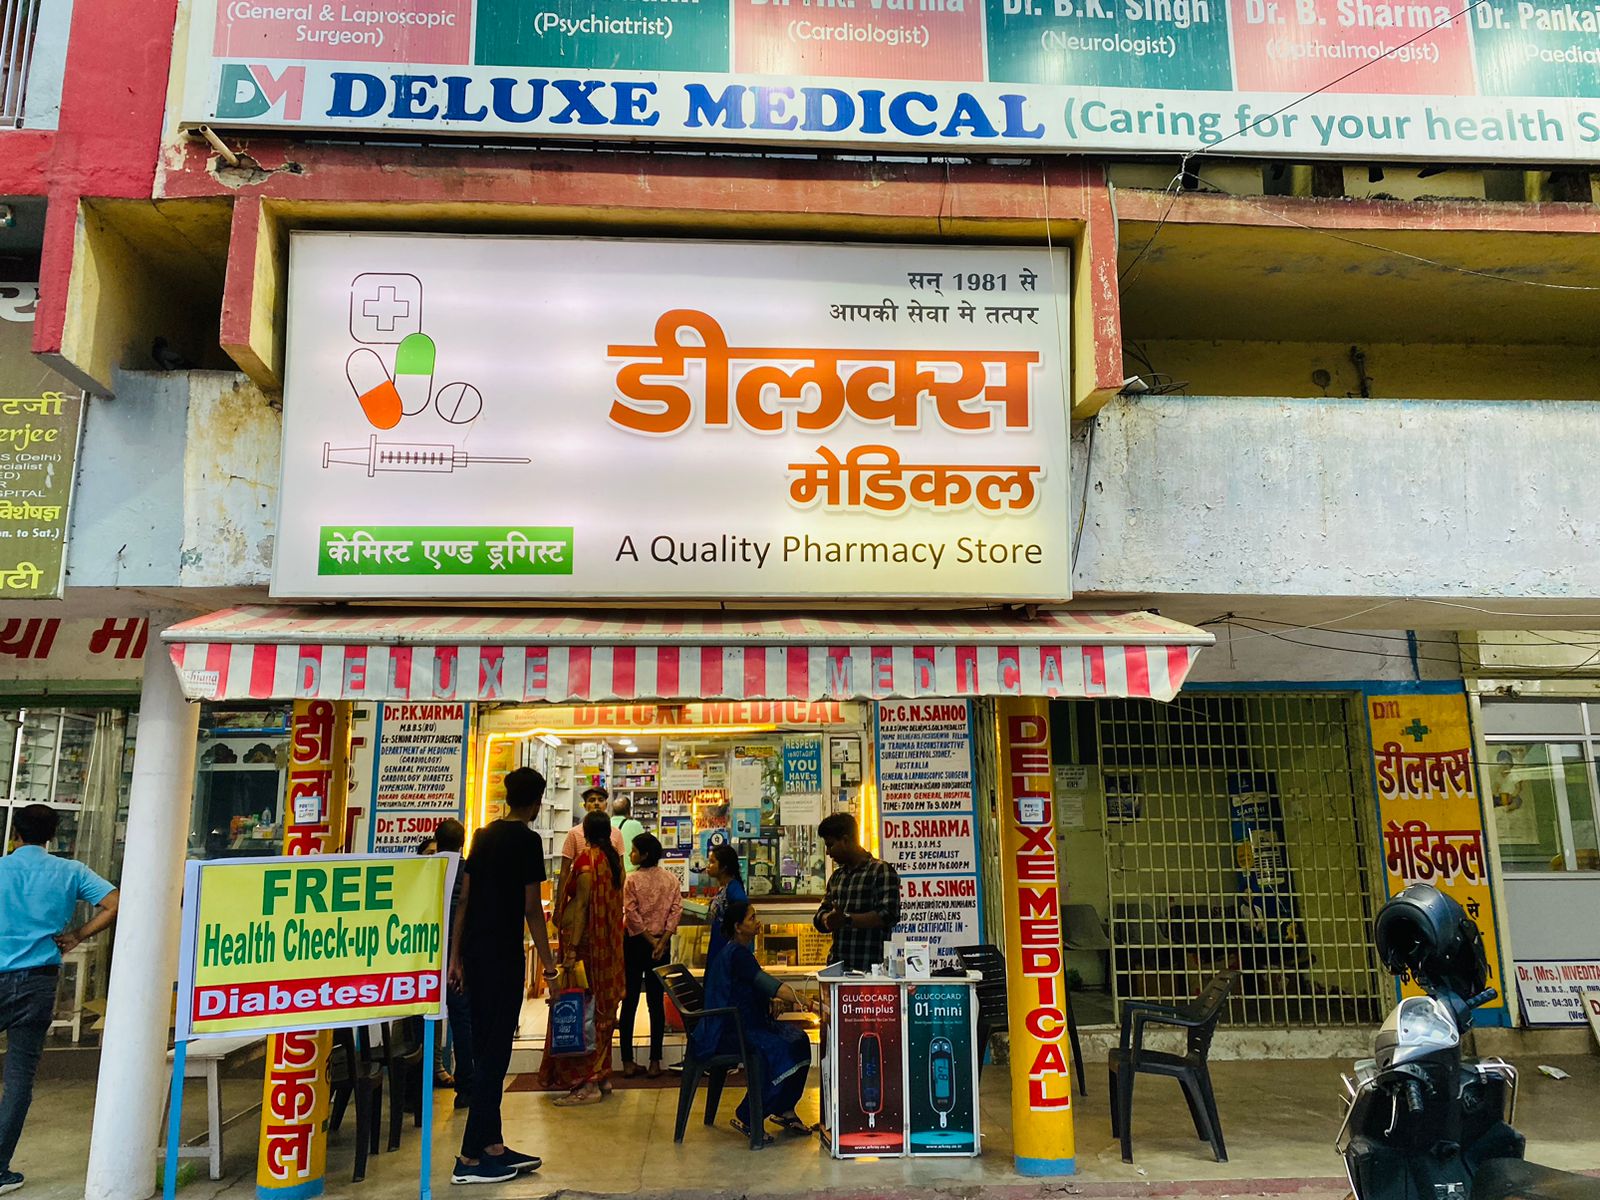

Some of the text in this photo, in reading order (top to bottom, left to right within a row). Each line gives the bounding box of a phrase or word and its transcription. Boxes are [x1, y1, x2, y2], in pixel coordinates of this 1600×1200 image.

[227, 2, 456, 28] (General & Laproscopic
[534, 12, 673, 39] (Psychiatrist)
[1246, 0, 1453, 30] Dr. B. Sharma
[1476, 2, 1511, 30] Dr.
[297, 26, 384, 48] Surgeon)
[787, 20, 930, 47] (Cardiologist)
[1041, 30, 1177, 57] (Neurologist)
[325, 71, 660, 127] DELUXE
[683, 83, 1046, 139] MEDICAL
[1064, 97, 1223, 144] (Caring
[1234, 104, 1298, 138] for
[1311, 110, 1411, 146] your
[1425, 108, 1563, 142] health
[909, 267, 1038, 296] सन् 1981 से
[830, 298, 898, 323] आपकी
[908, 300, 949, 324] सेवा
[986, 305, 1039, 325] तत्पर
[607, 308, 1040, 433] डीलक्स
[0, 423, 58, 450] erjee
[0, 463, 43, 471] cialist
[788, 444, 1041, 511] मेडिकल
[327, 531, 413, 564] केमिस्ट
[421, 540, 479, 569] एण्ड
[615, 534, 1043, 569] A Quality Pharmacy Store
[297, 655, 1107, 698] DELUXE MEDICAL
[384, 705, 400, 720] Dr.
[573, 704, 692, 725] DELUXE
[701, 702, 846, 724] MEDICAL
[880, 706, 896, 721] Dr.
[786, 739, 818, 749] RESPECT
[788, 759, 818, 771] YOU
[789, 772, 810, 780] HAVE
[1374, 741, 1474, 798] डीलक्स
[661, 790, 692, 804] DELUXE
[785, 781, 806, 792] EARN
[377, 818, 395, 833] Dr.
[884, 820, 901, 838] Dr.
[899, 850, 960, 860] EYE SPECIALIST
[1384, 820, 1486, 882] मेडिकल
[262, 866, 394, 916] FREE
[203, 913, 439, 967] Health Check-up Camp
[1517, 965, 1532, 981] Dr.
[198, 974, 438, 1016] Diabetes/BP
[842, 993, 895, 1002] GLUCOCARD
[914, 993, 962, 1001] GLUCOCARD
[1018, 887, 1070, 1113] MEDICAL
[914, 1002, 963, 1017] 01-mini
